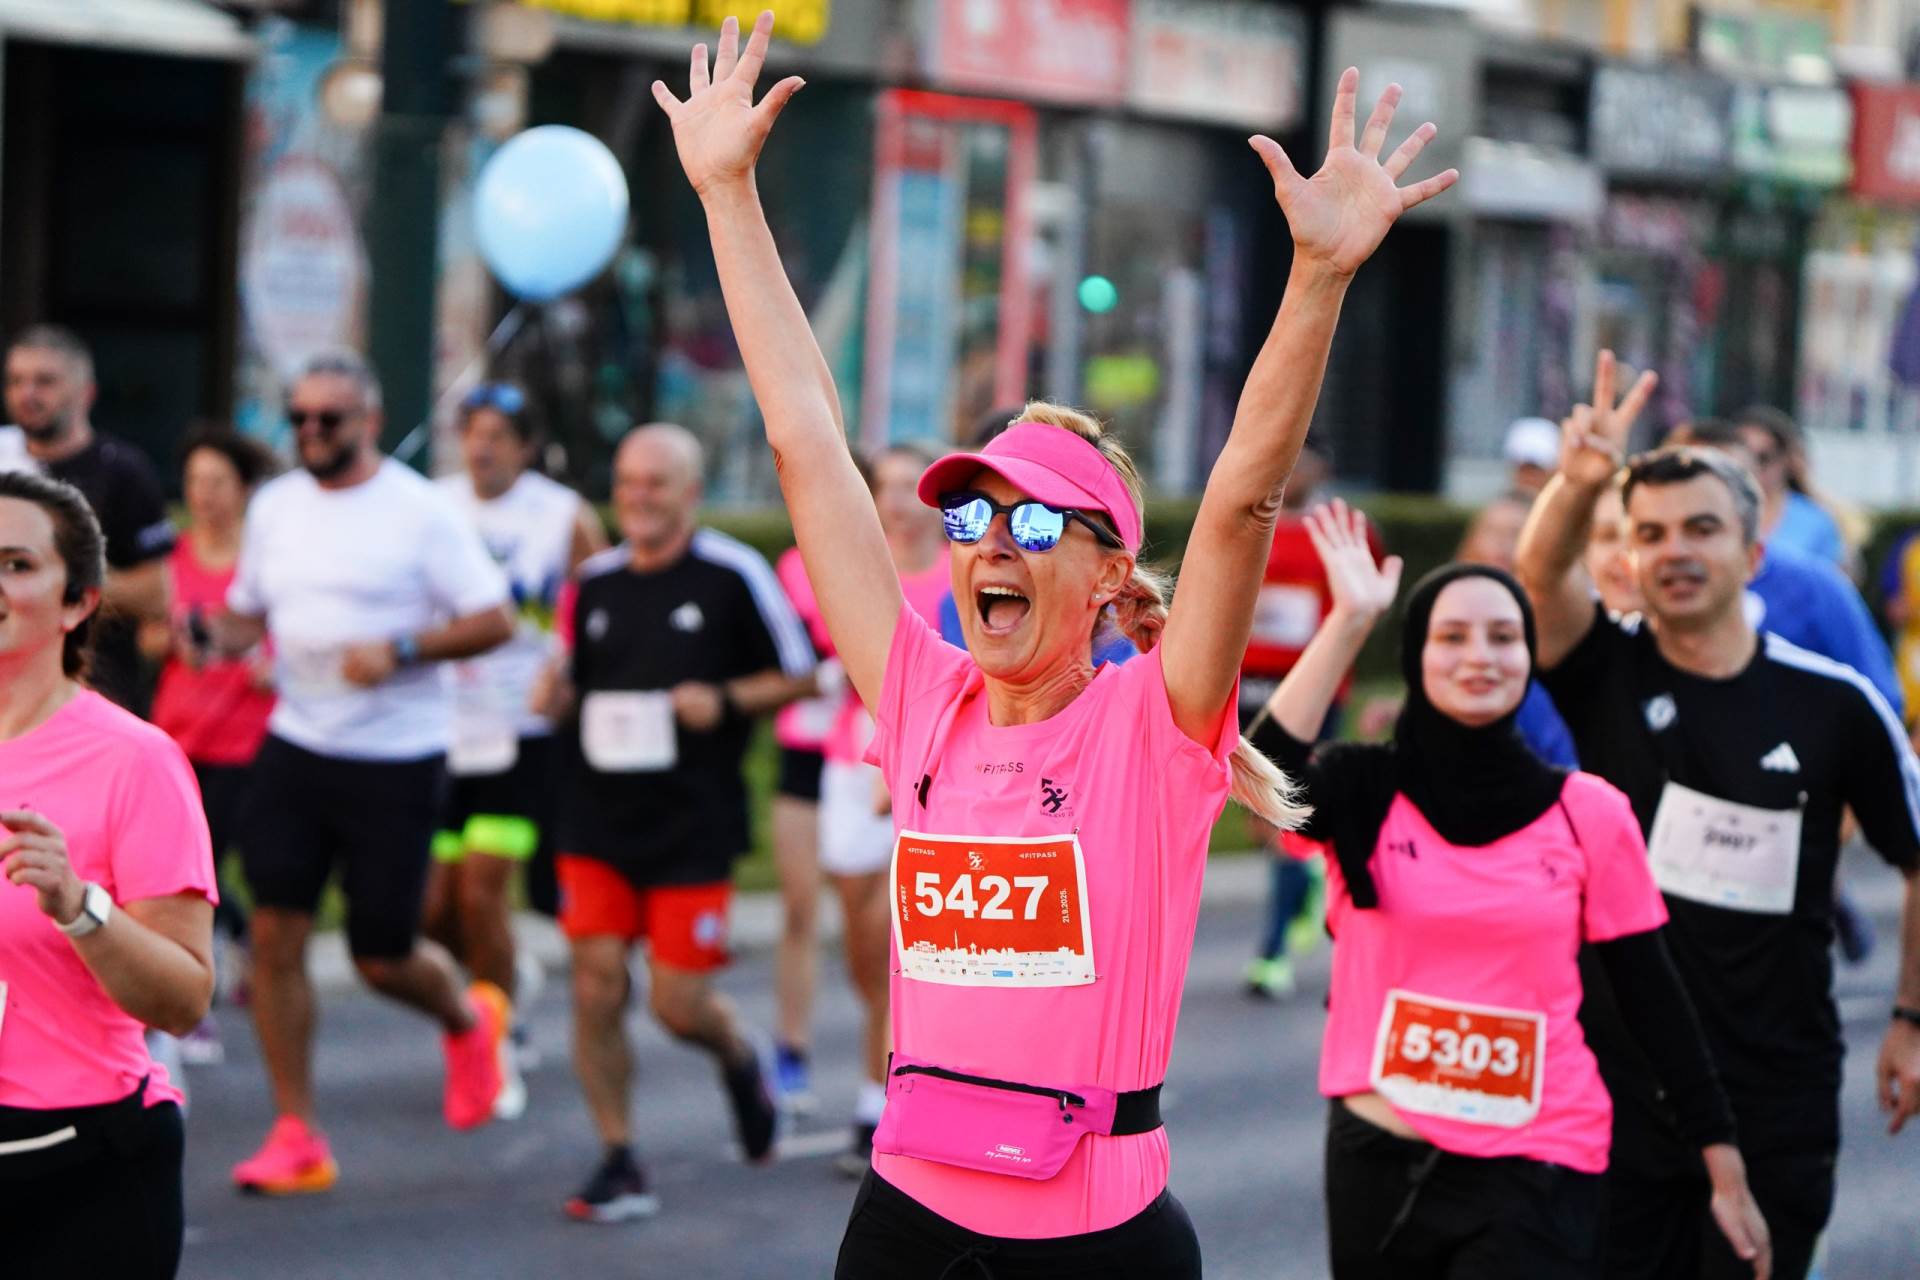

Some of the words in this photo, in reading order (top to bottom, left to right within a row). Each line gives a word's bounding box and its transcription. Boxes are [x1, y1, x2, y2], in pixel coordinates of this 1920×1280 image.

[1024, 851, 1057, 860] FITPASS
[914, 871, 1050, 921] 5427
[1401, 1022, 1520, 1077] 5303
